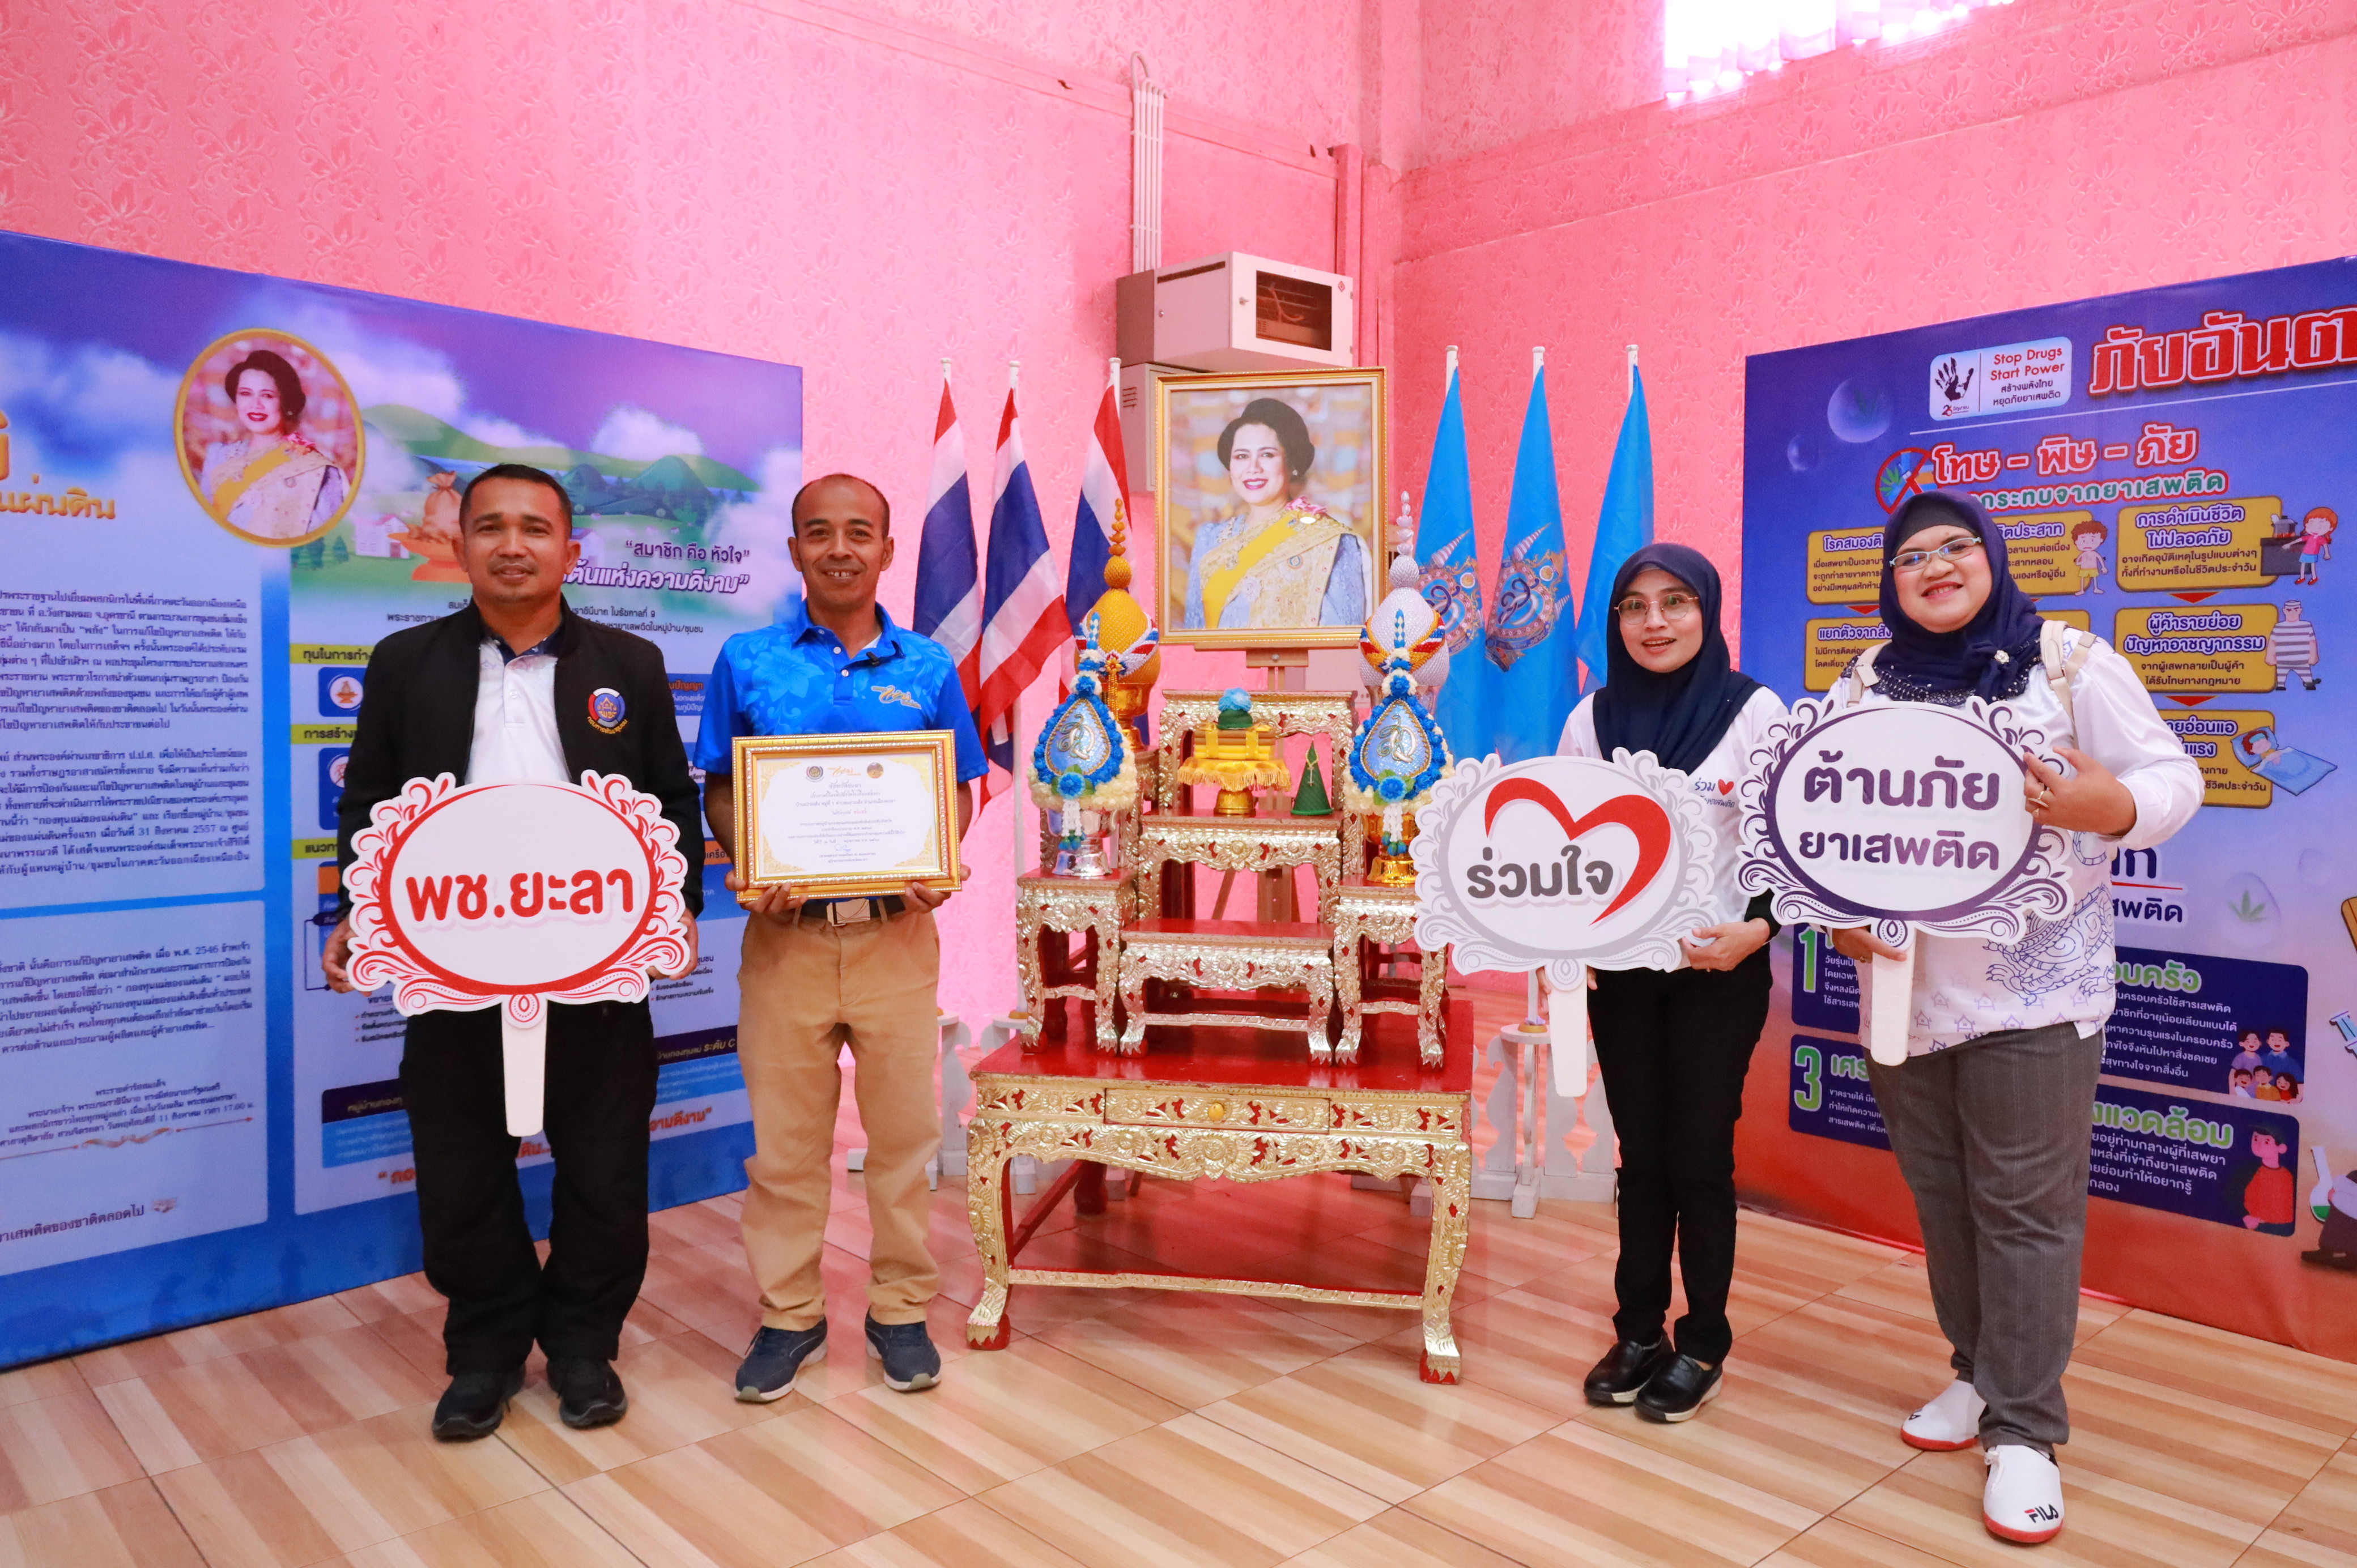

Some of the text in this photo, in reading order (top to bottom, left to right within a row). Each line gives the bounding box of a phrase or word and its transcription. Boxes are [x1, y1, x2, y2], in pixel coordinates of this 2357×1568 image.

[1994, 348, 2062, 365] Stop Drugs
[1990, 363, 2065, 381] Start Power
[2001, 380, 2053, 393] สร้างพลังไทย
[1993, 390, 2061, 407] หยุดภัยยาเสพติด
[1933, 445, 1999, 483] โทษ
[2038, 437, 2096, 474] พิษ
[2136, 424, 2198, 466] ภัย
[2137, 504, 2245, 528] การดำเนินชีวิต
[1824, 534, 1884, 550] โรคสมองติ
[2146, 527, 2231, 549] ไม่ปลอดภัย
[687, 544, 707, 561] คือ
[563, 559, 750, 594] ต้นแห่งความดีงาม”
[2148, 611, 2242, 634] ผู้ค้ารายย่อย
[2124, 634, 2265, 654] ปัญหาอาชญากรรม
[303, 647, 373, 662] ทุนในการกำ
[2141, 661, 2244, 674] จากผู้เสพกลายเป็นผู้ค้า
[2146, 674, 2241, 687] ได้รับโทษทางกฎหมาย
[304, 726, 358, 739] การสร้าง
[1695, 777, 1716, 792] ร่วม
[1804, 749, 2000, 811] ต้านภัย
[138, 828, 149, 836] 31
[193, 824, 216, 834] 2557
[1799, 830, 1999, 871] ยาเสพติด
[1466, 844, 1614, 899] ร่วมใจ
[405, 868, 633, 922] พช.ยะลา
[195, 945, 219, 956] 2546
[1799, 926, 1817, 993] 1
[728, 1038, 736, 1048] C
[2101, 1055, 2189, 1077] สุขทางใจจากสิ่งอื่น
[1794, 1045, 1822, 1112] 3
[2024, 1504, 2058, 1523] FILA
